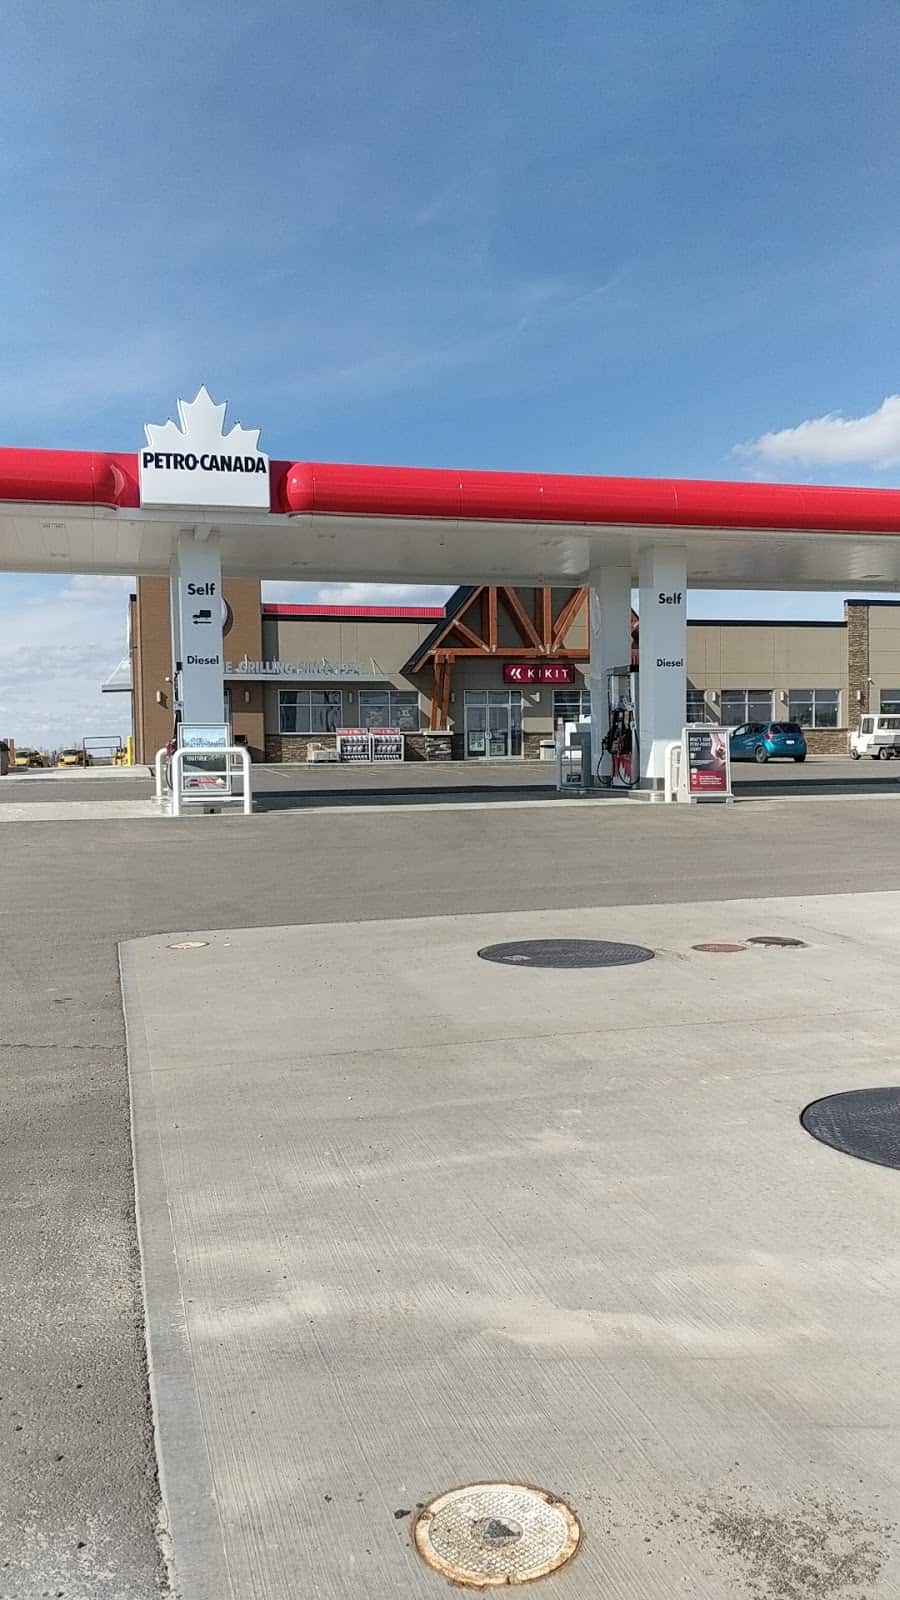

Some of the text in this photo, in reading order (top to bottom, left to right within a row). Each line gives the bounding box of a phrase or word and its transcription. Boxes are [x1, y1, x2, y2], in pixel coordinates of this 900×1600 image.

[187, 583, 216, 596] Self
[658, 592, 682, 605] Self
[187, 655, 219, 665] Diesel
[656, 658, 684, 668] Diesel
[527, 669, 569, 679] KIKIT
